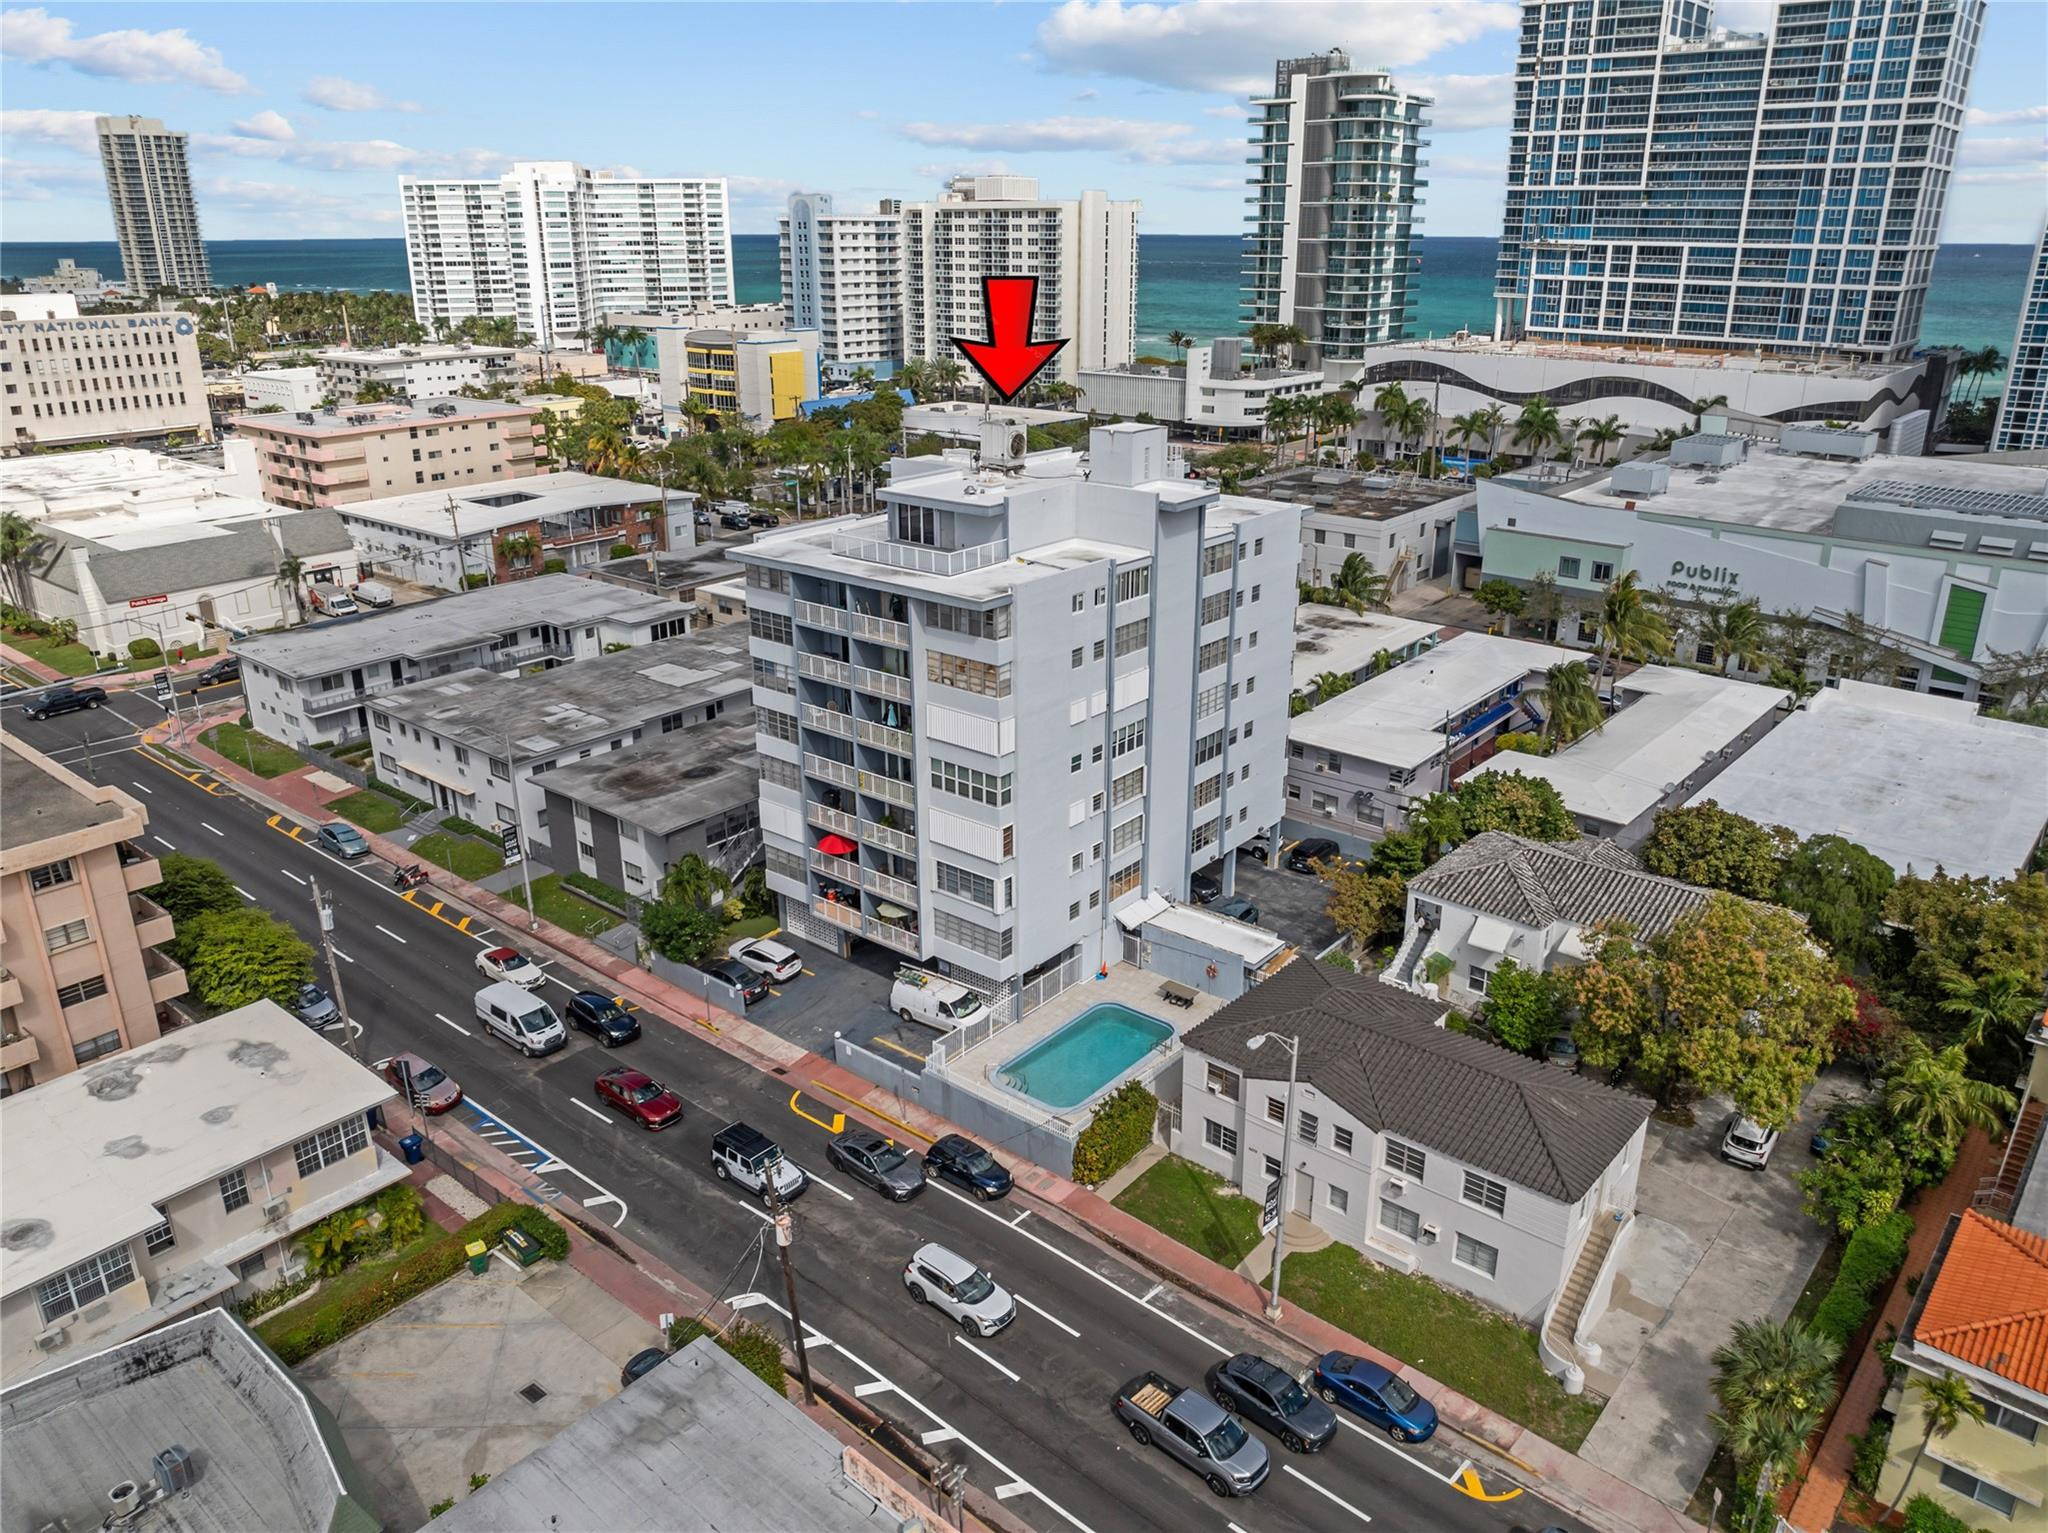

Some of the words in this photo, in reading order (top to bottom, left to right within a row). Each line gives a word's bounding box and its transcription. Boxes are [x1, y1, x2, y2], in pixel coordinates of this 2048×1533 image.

[34, 320, 120, 333] NATIONAL
[128, 317, 172, 328] BANK
[1671, 561, 1739, 585] Publix
[1666, 580, 1688, 589] FOOD
